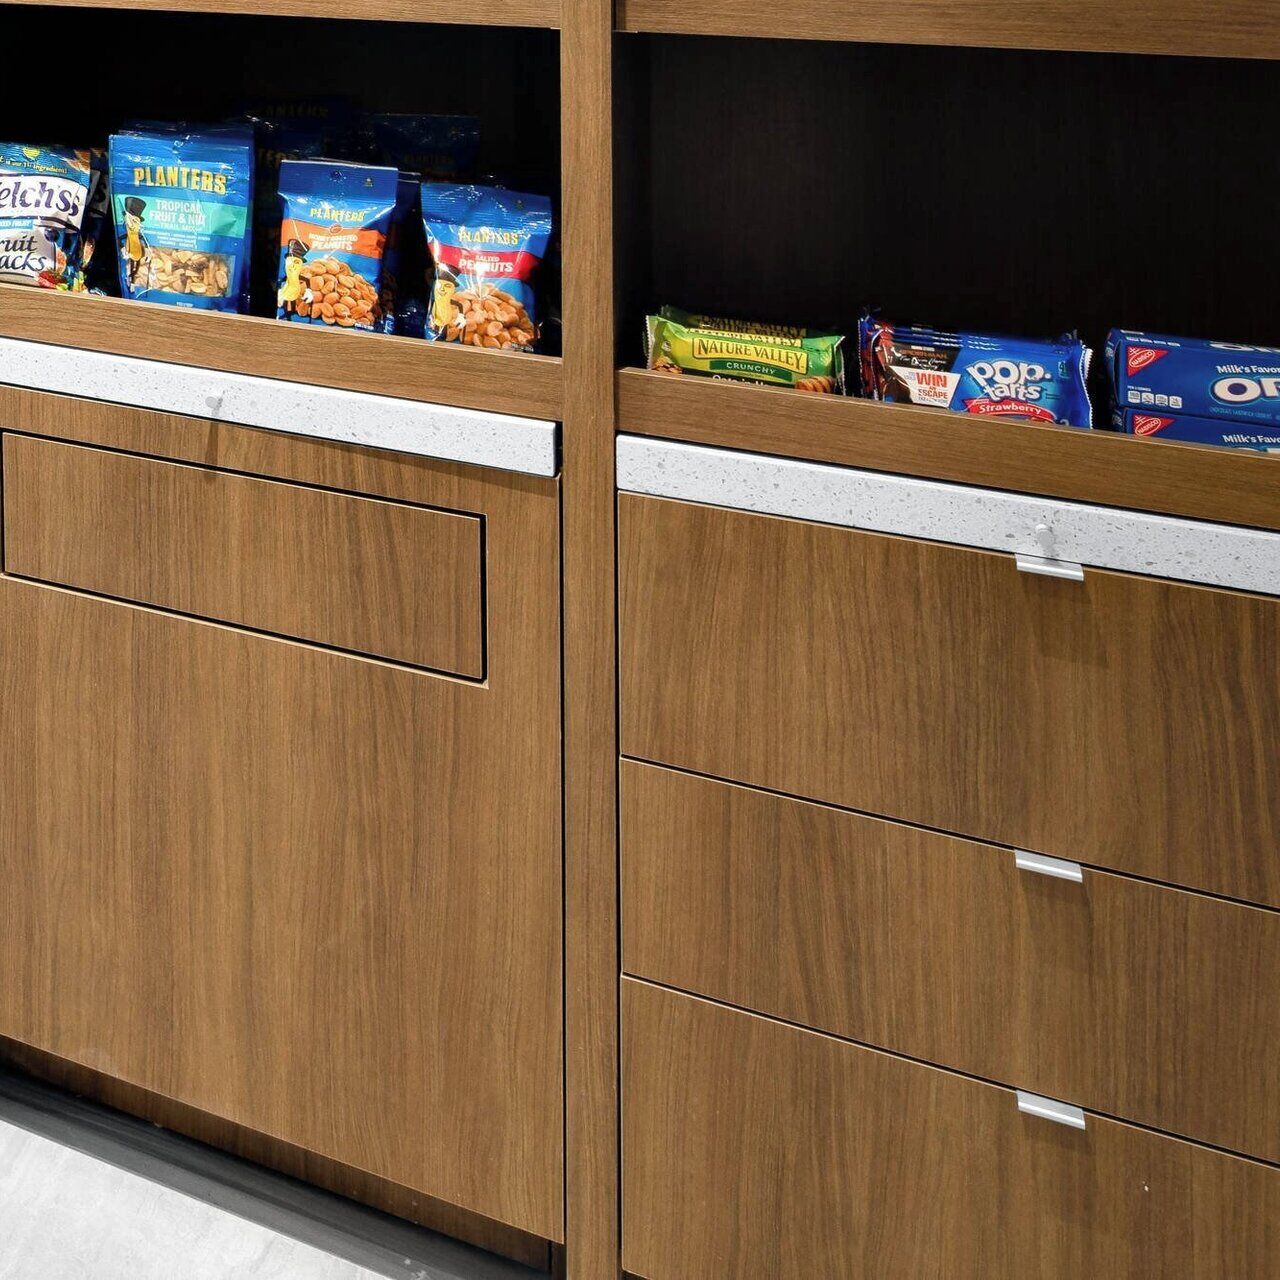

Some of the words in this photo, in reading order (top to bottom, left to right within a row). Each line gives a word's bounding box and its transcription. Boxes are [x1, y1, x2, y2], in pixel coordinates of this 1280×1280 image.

[133, 166, 227, 195] PLANTERS
[149, 210, 178, 222] FRUIT
[309, 206, 365, 222] PLANTERS
[458, 226, 520, 246] PLANTERS
[311, 240, 353, 251] PEANUTS
[697, 338, 752, 357] NATURE
[753, 346, 805, 371] VALLEY
[1130, 349, 1155, 366] NABISCO
[726, 361, 776, 376] CRUNCHY
[1216, 365, 1251, 374] Milk's
[916, 372, 948, 388] WIN
[918, 388, 948, 399] ESCAPE
[983, 383, 1041, 402] tarts
[978, 402, 1042, 416] Strawberry
[1137, 418, 1161, 435] NABISCO
[1222, 434, 1257, 443] Milk's
